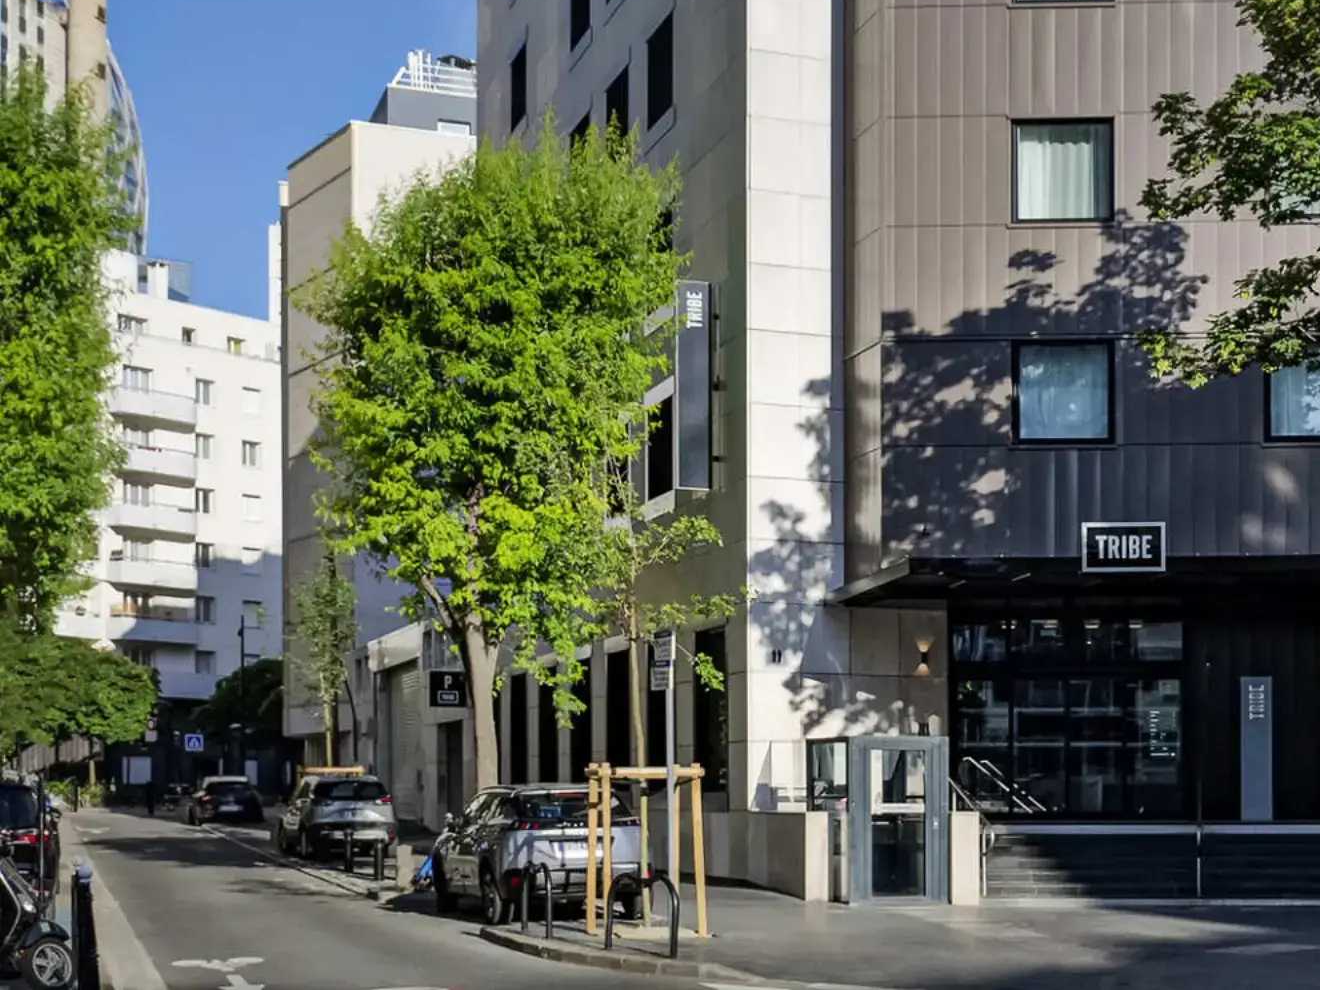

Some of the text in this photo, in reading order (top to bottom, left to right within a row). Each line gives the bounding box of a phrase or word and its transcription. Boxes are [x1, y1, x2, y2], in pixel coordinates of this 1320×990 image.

[686, 290, 703, 329] TRIBE
[1095, 534, 1153, 559] TRIBE
[444, 675, 453, 689] P
